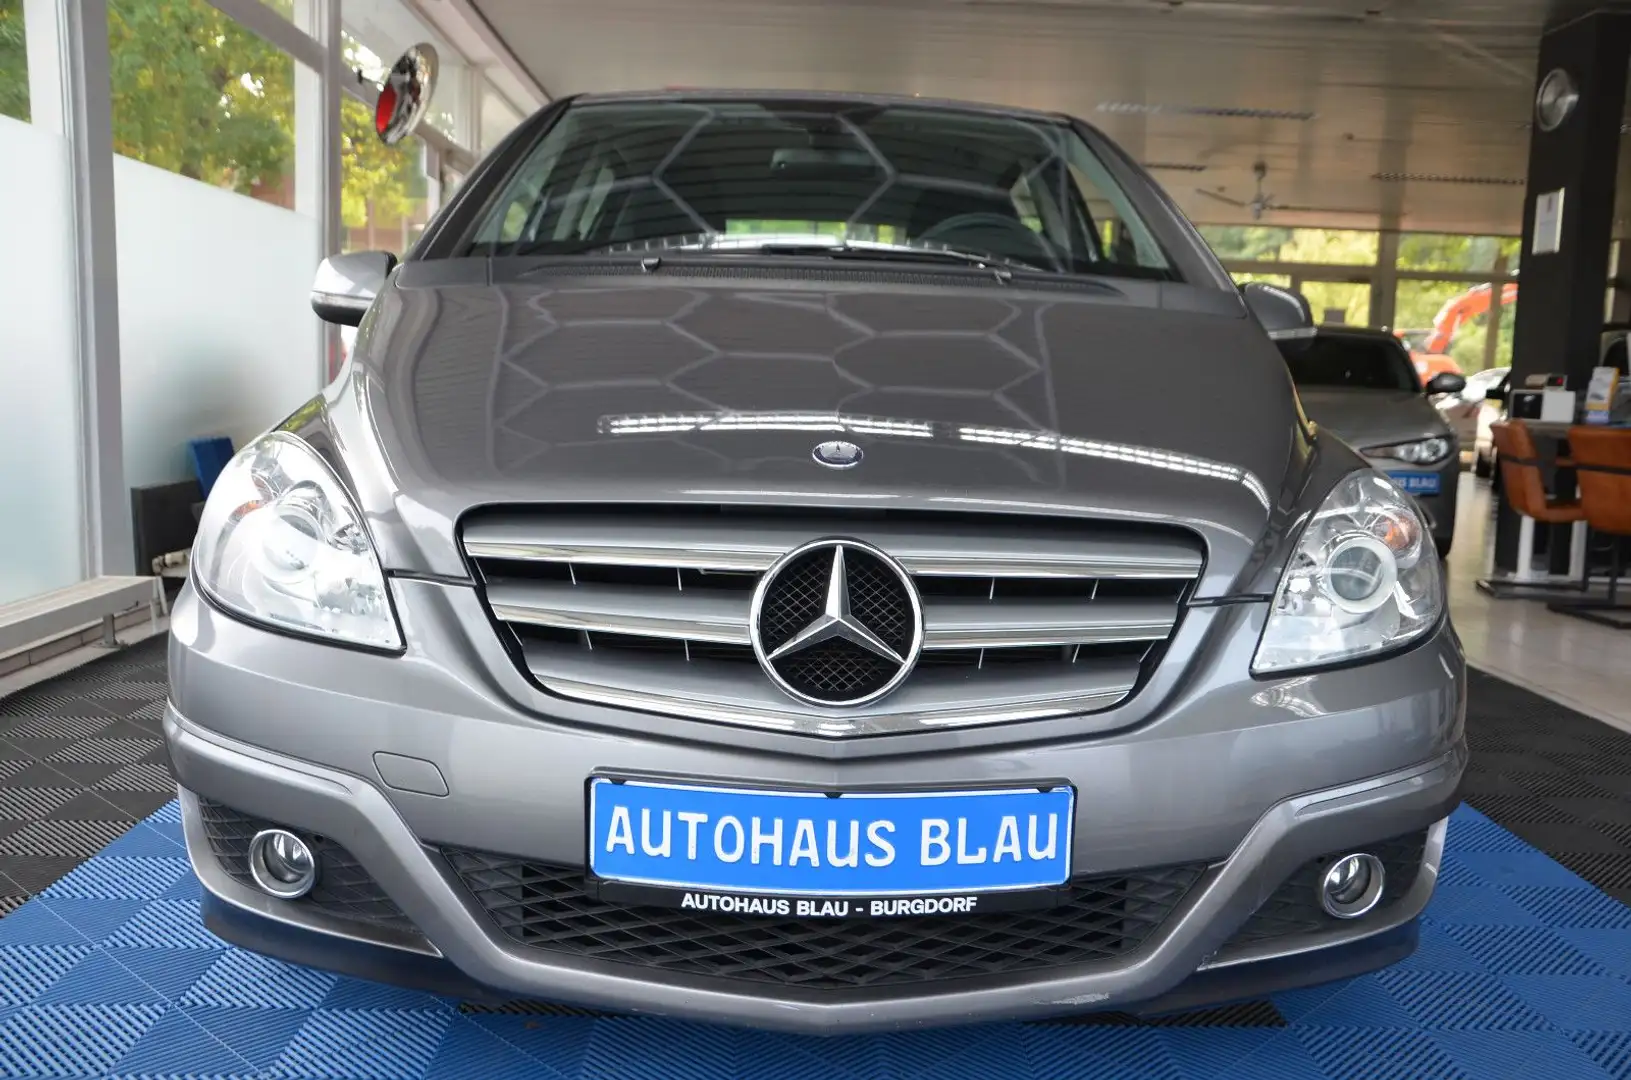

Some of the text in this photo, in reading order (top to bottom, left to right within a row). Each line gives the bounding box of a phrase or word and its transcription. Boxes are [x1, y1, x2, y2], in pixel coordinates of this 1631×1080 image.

[605, 804, 1059, 869] AUTOHAUS BLAU
[680, 892, 791, 916] AUTOHAUS
[796, 899, 849, 917] BLAU
[869, 896, 978, 917] BURGDORF
